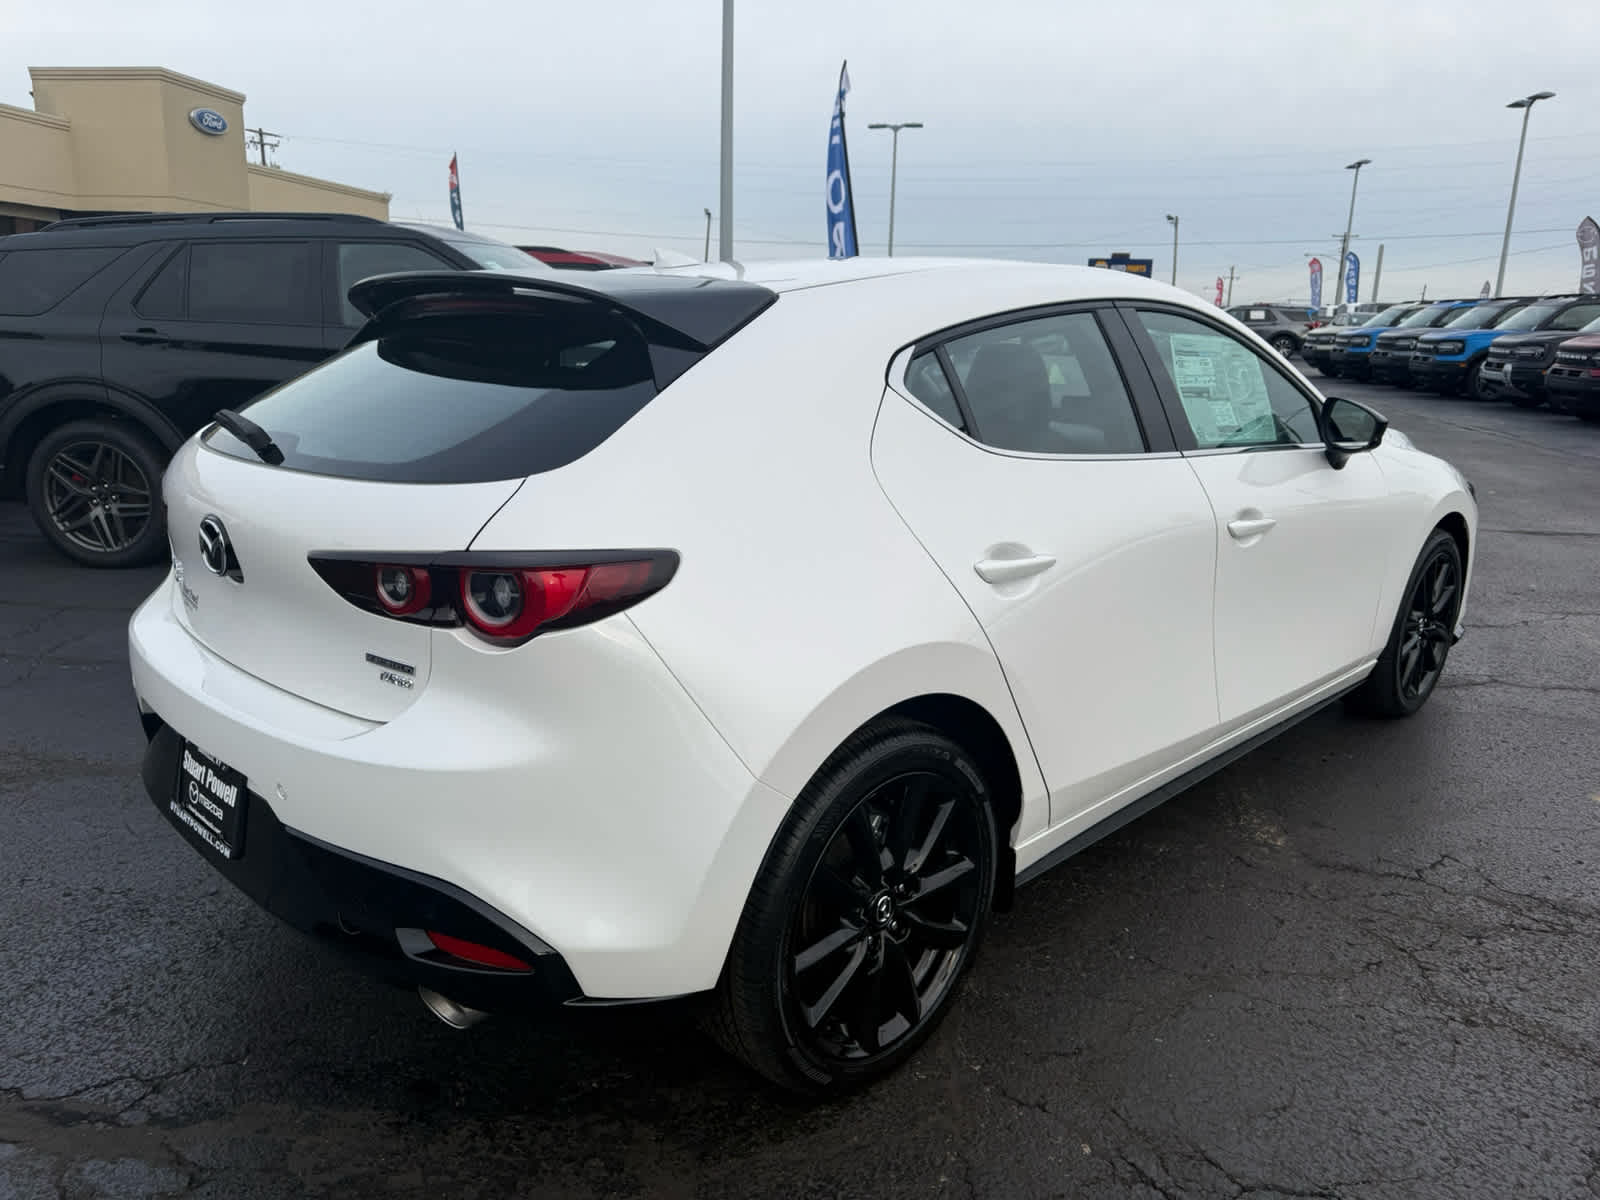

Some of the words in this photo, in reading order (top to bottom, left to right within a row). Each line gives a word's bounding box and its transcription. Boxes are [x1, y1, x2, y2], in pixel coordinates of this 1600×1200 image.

[202, 112, 223, 129] Ford
[182, 749, 207, 785] Stuart
[206, 768, 238, 808] Powell
